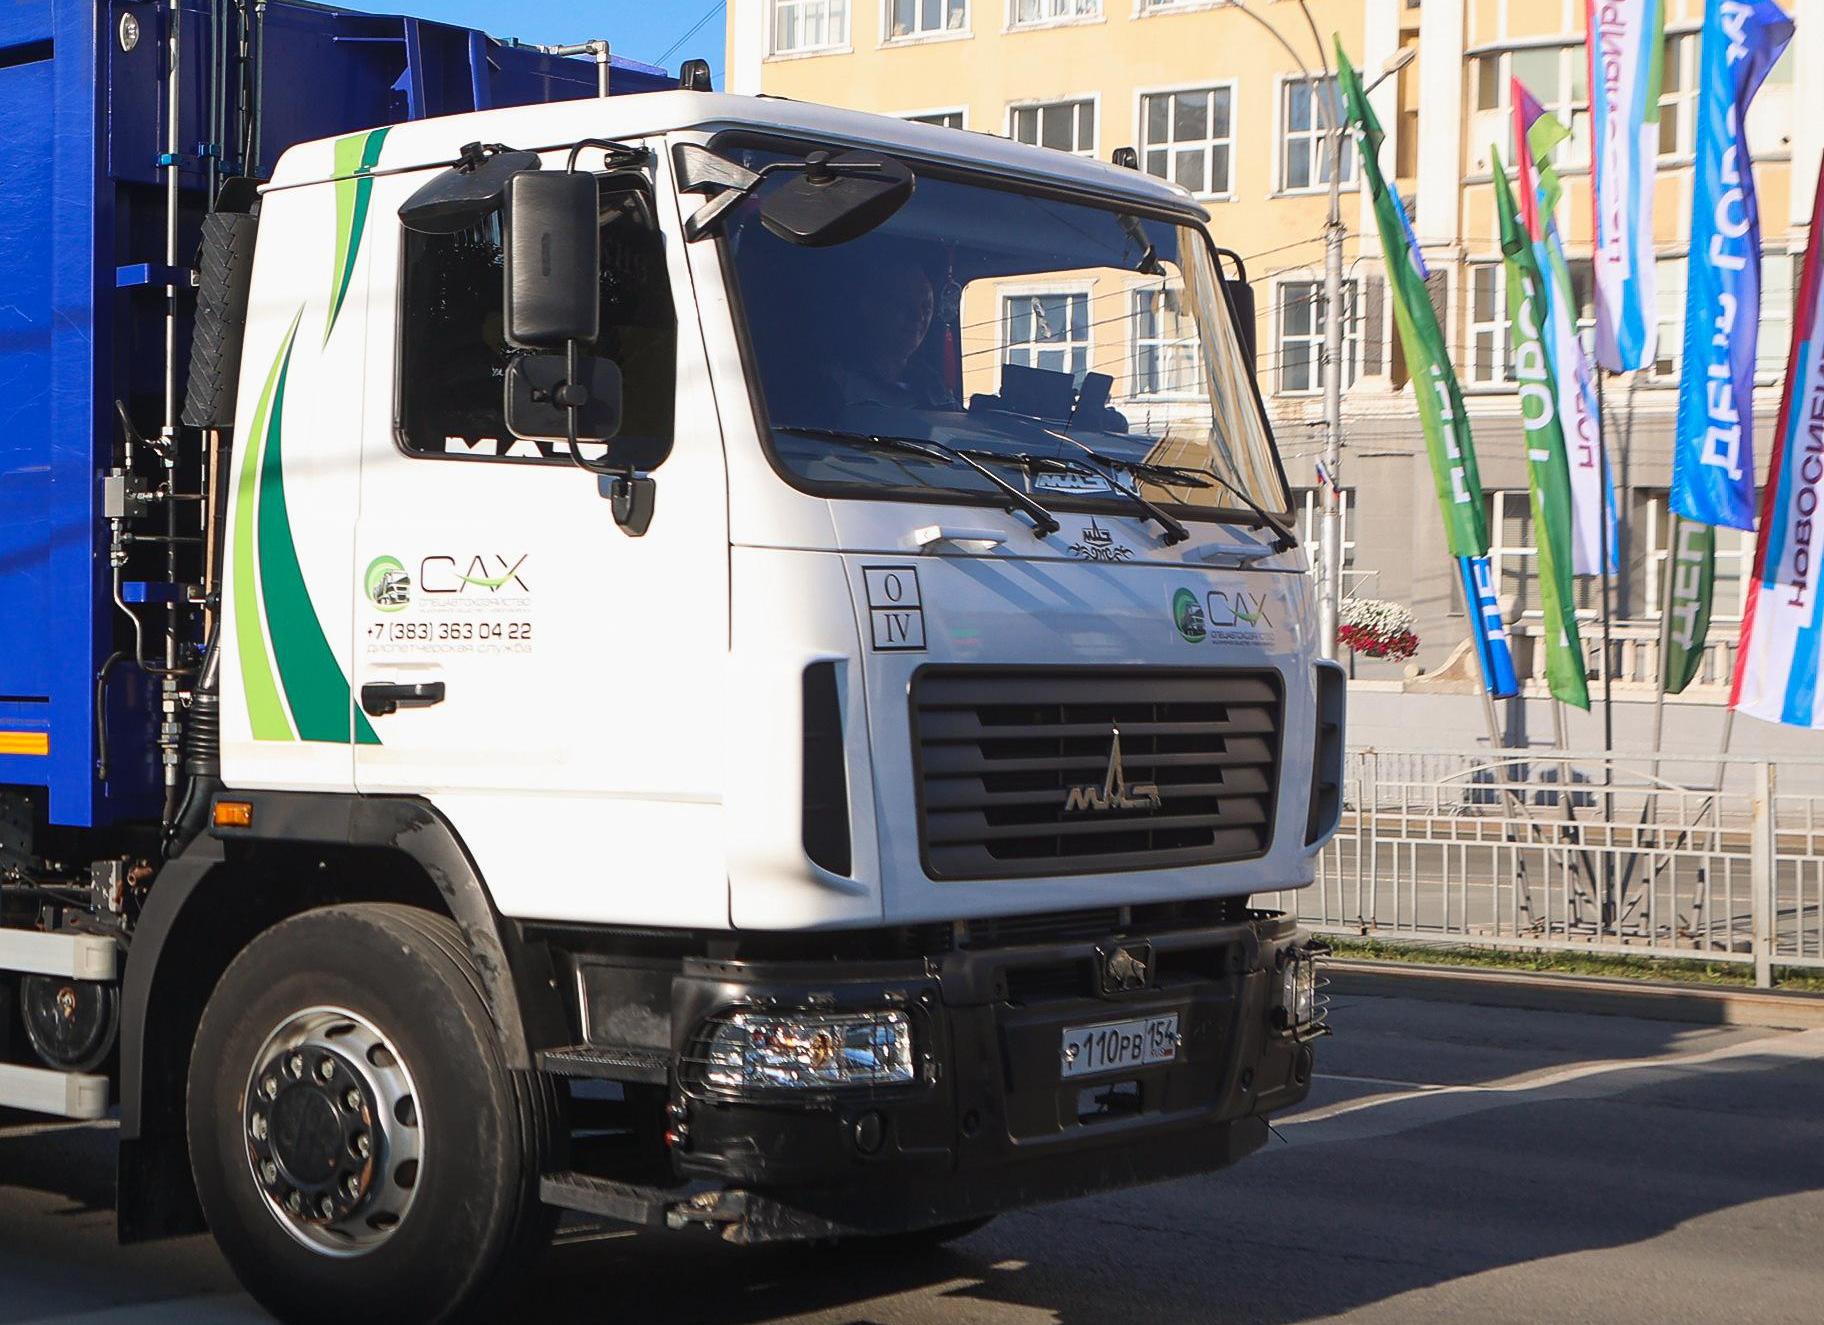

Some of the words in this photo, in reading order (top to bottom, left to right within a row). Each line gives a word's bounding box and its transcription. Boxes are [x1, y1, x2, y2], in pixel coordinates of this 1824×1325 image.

[420, 553, 529, 593] САХ
[1207, 590, 1273, 628] САХ
[367, 622, 384, 640] +7
[389, 622, 433, 642] (383)
[439, 622, 473, 640] 363
[479, 622, 502, 640] 04
[508, 622, 532, 640] 22
[884, 612, 912, 643] IV
[1147, 1019, 1175, 1049] 154
